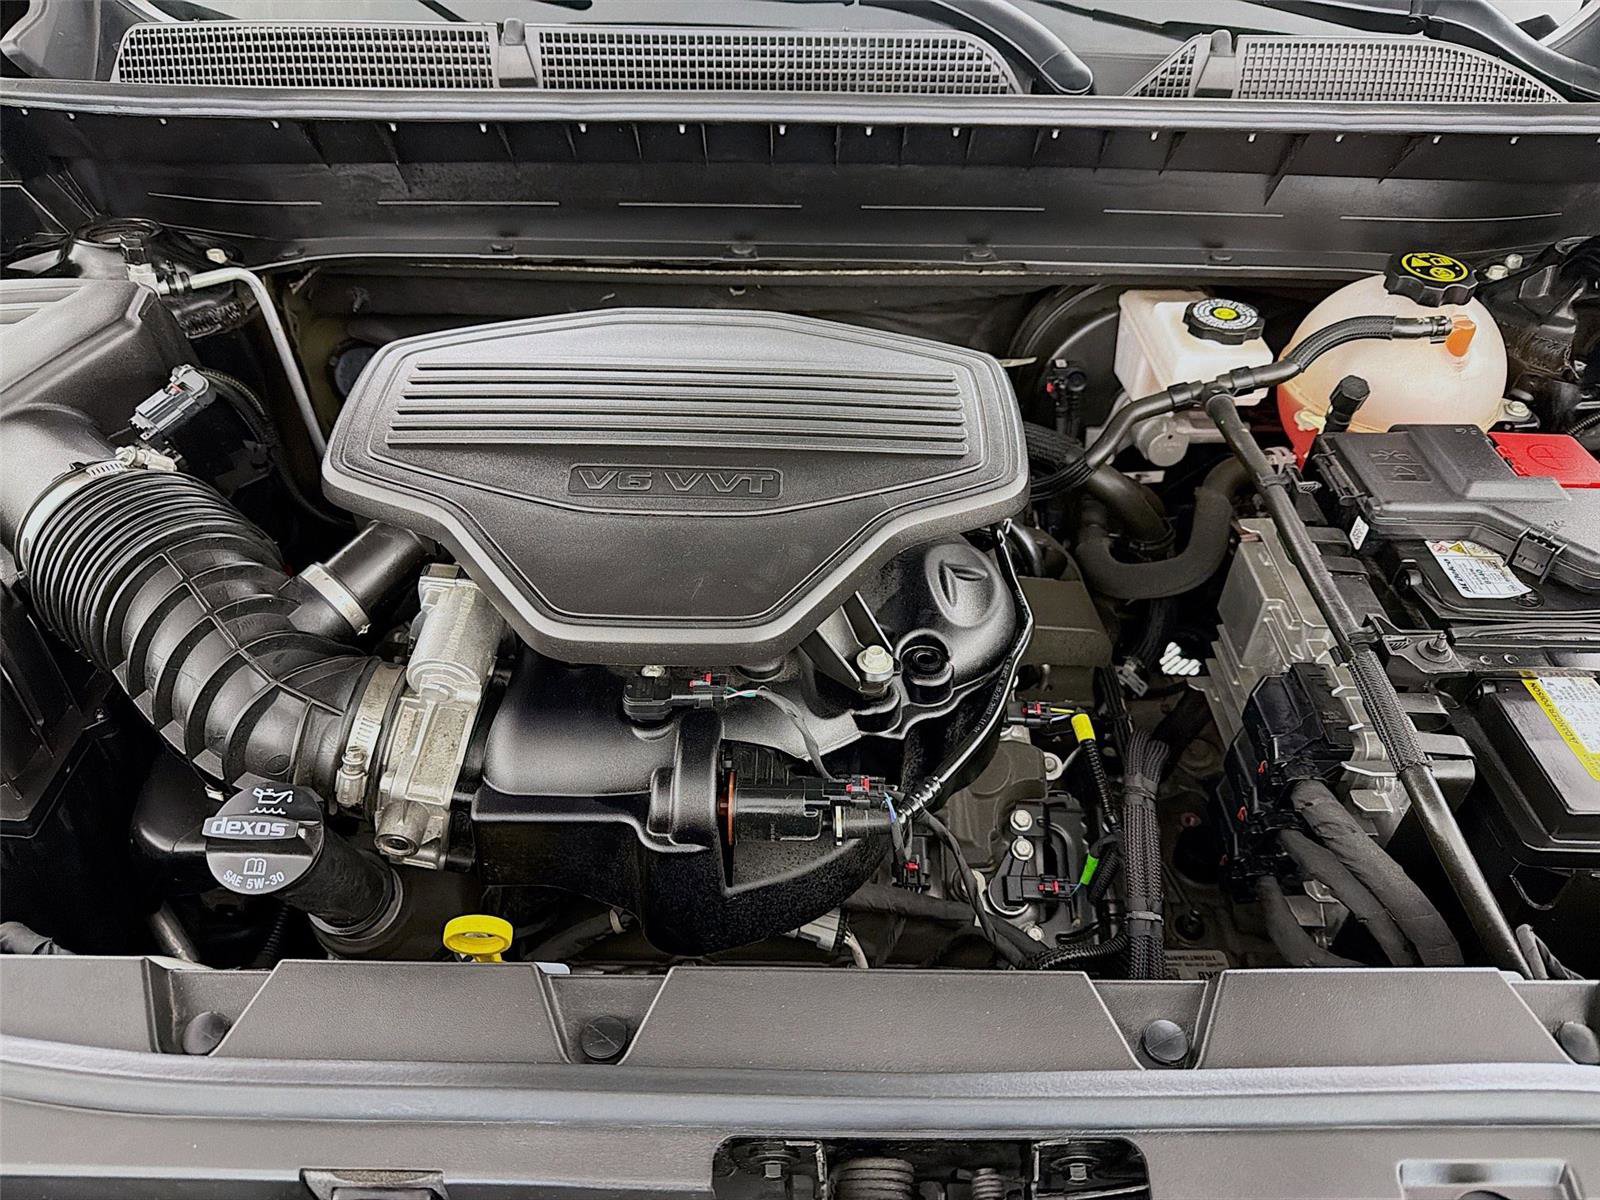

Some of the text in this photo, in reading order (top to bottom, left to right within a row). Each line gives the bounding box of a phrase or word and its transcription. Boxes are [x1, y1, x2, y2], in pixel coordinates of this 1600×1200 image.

[578, 470, 774, 494] V6 VVT
[210, 817, 288, 837] dexos
[223, 869, 285, 890] SAE 5W-30
